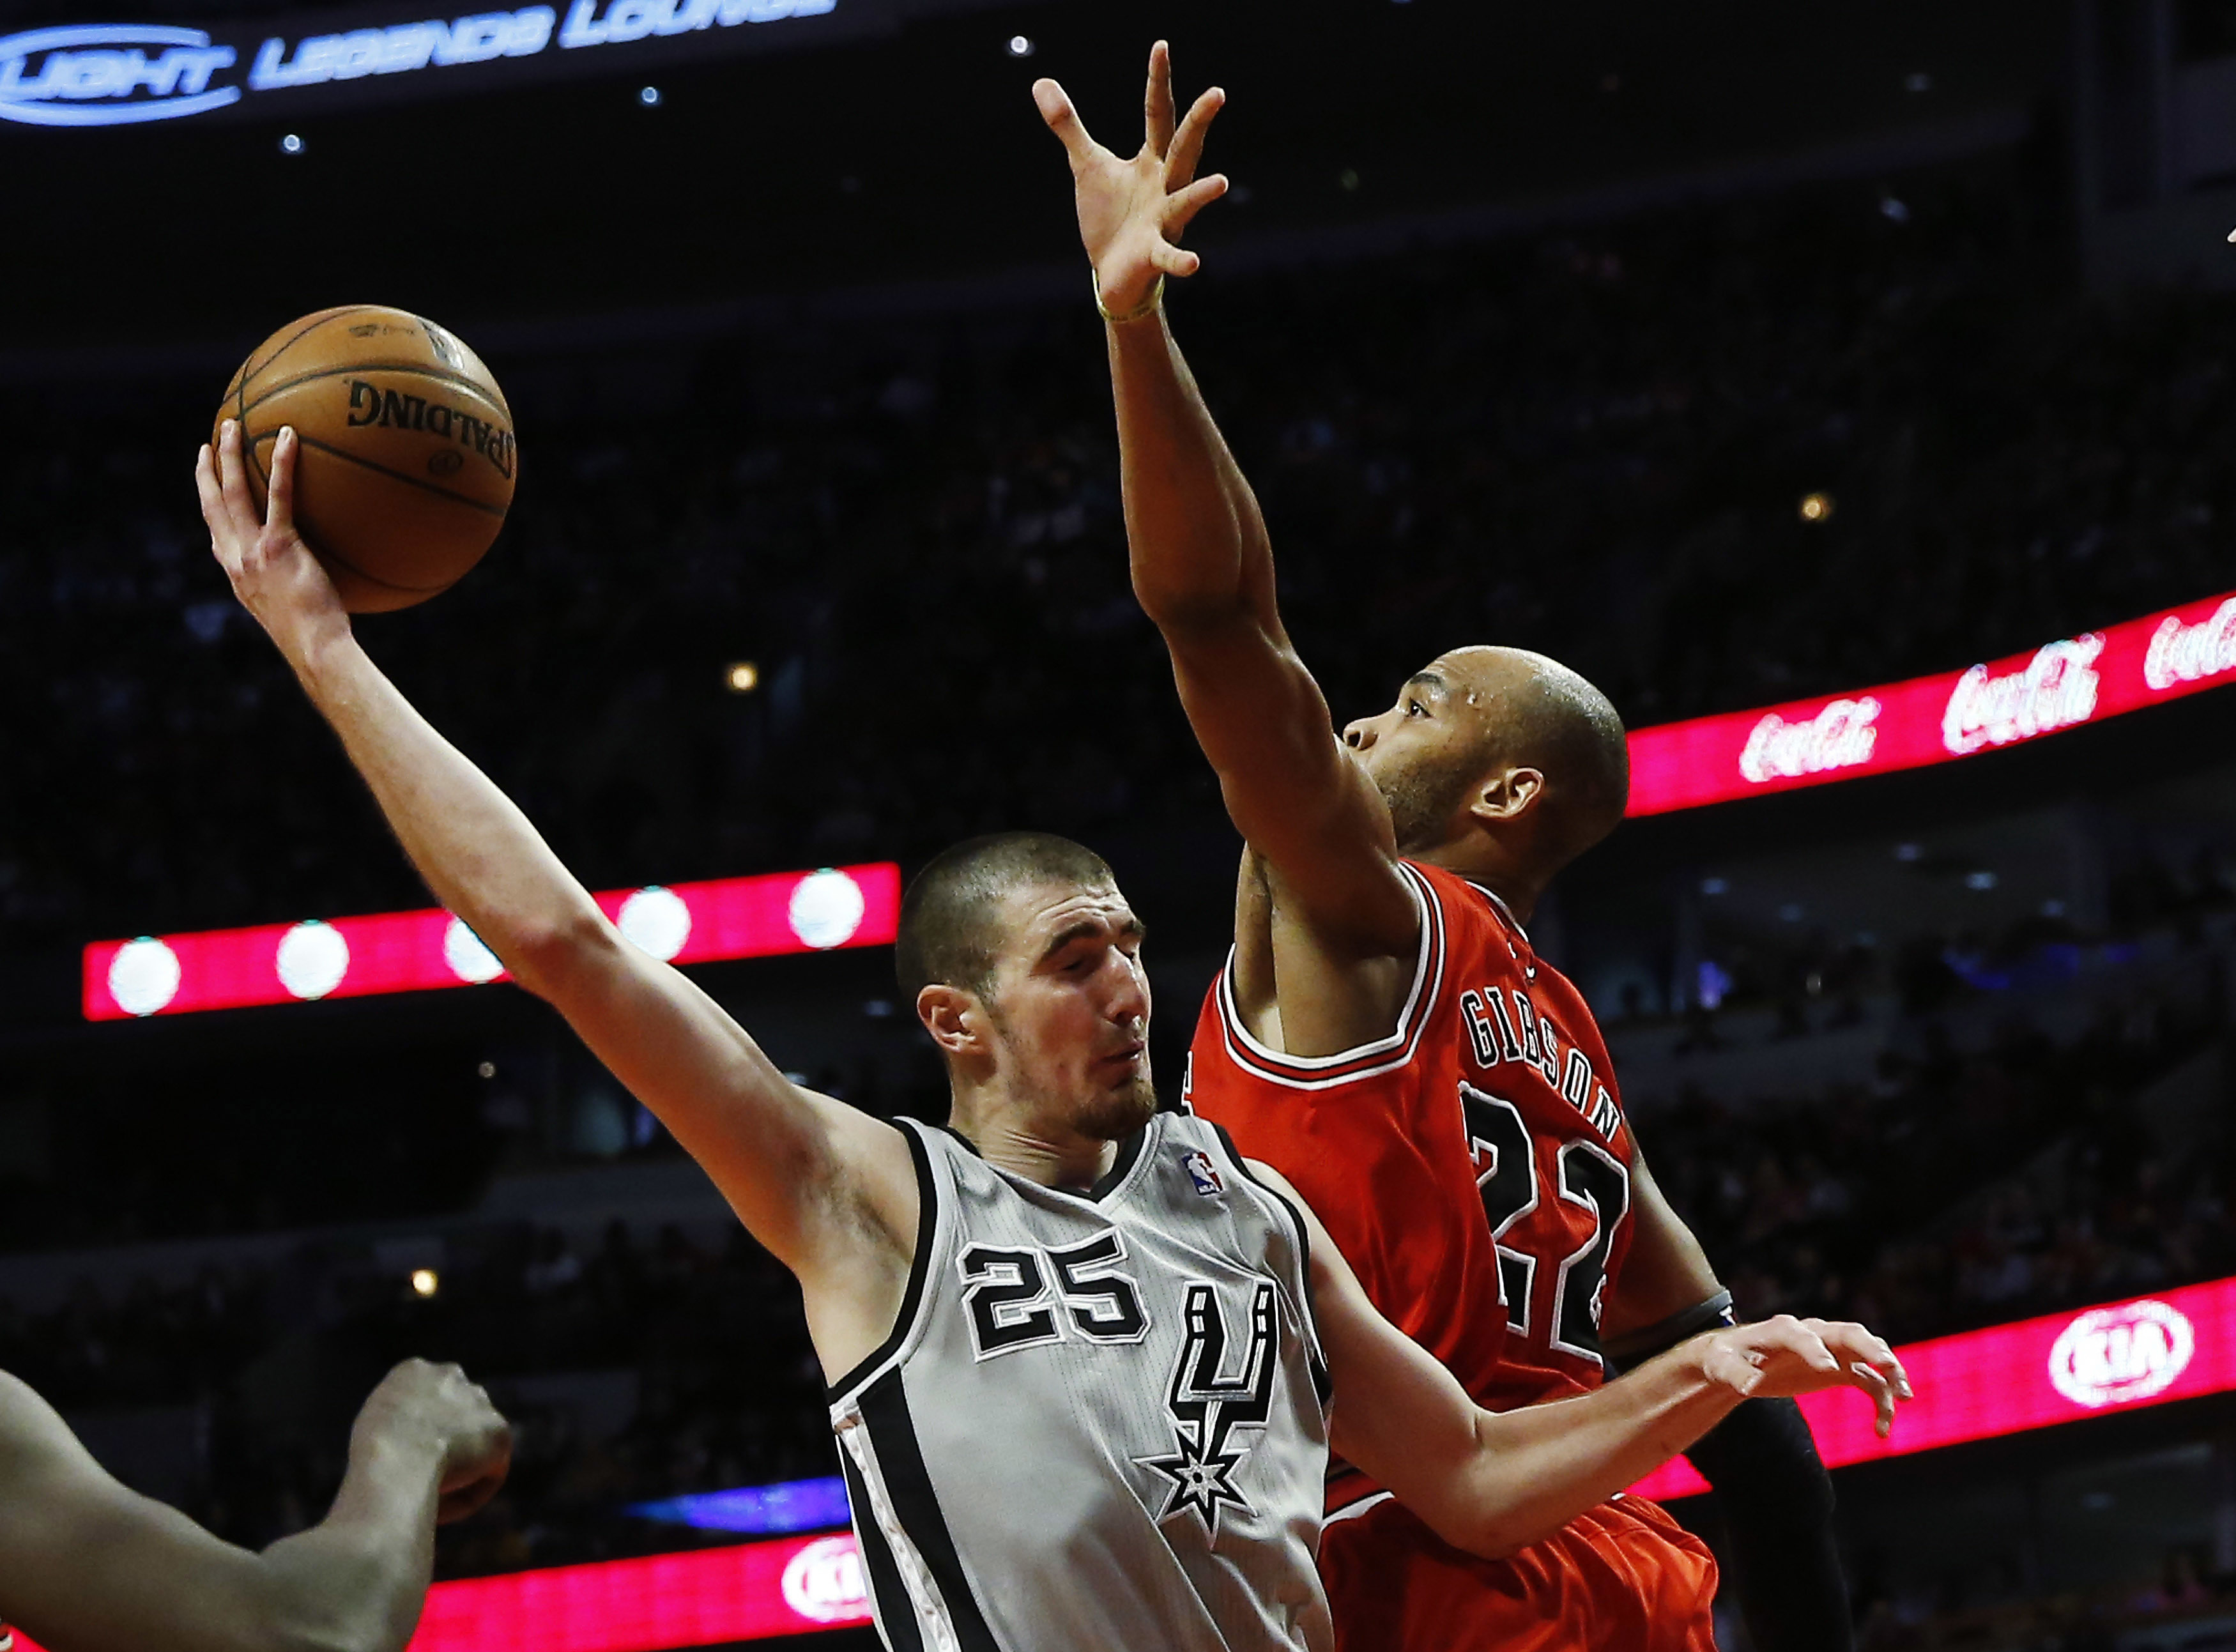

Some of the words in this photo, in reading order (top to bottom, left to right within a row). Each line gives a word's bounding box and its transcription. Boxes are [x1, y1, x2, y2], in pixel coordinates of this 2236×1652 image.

[248, 4, 556, 91] LEGENDS
[1460, 986, 1621, 1143] GIBSON
[957, 1225, 1151, 1363] 25
[1459, 1080, 1630, 1367] 22
